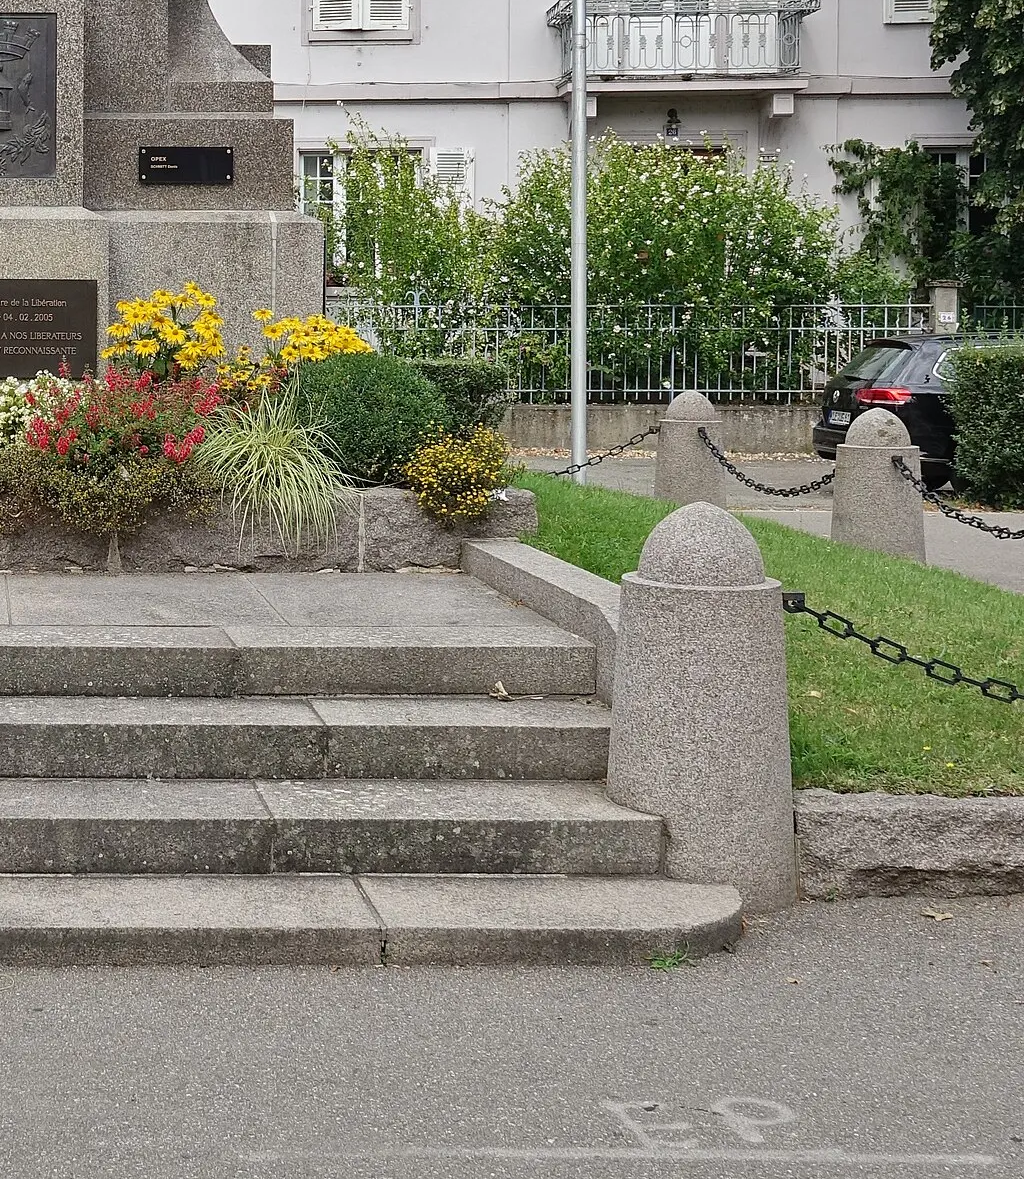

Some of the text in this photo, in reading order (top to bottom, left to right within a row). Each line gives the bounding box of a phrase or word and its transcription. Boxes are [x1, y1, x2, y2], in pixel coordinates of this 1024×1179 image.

[10, 298, 21, 307] de
[22, 298, 29, 307] la
[31, 298, 67, 308] Libération
[0, 332, 8, 341] A
[9, 331, 28, 341] NOS
[29, 332, 83, 341] LIBERATEURS
[3, 346, 77, 355] RECONNAISSANTE
